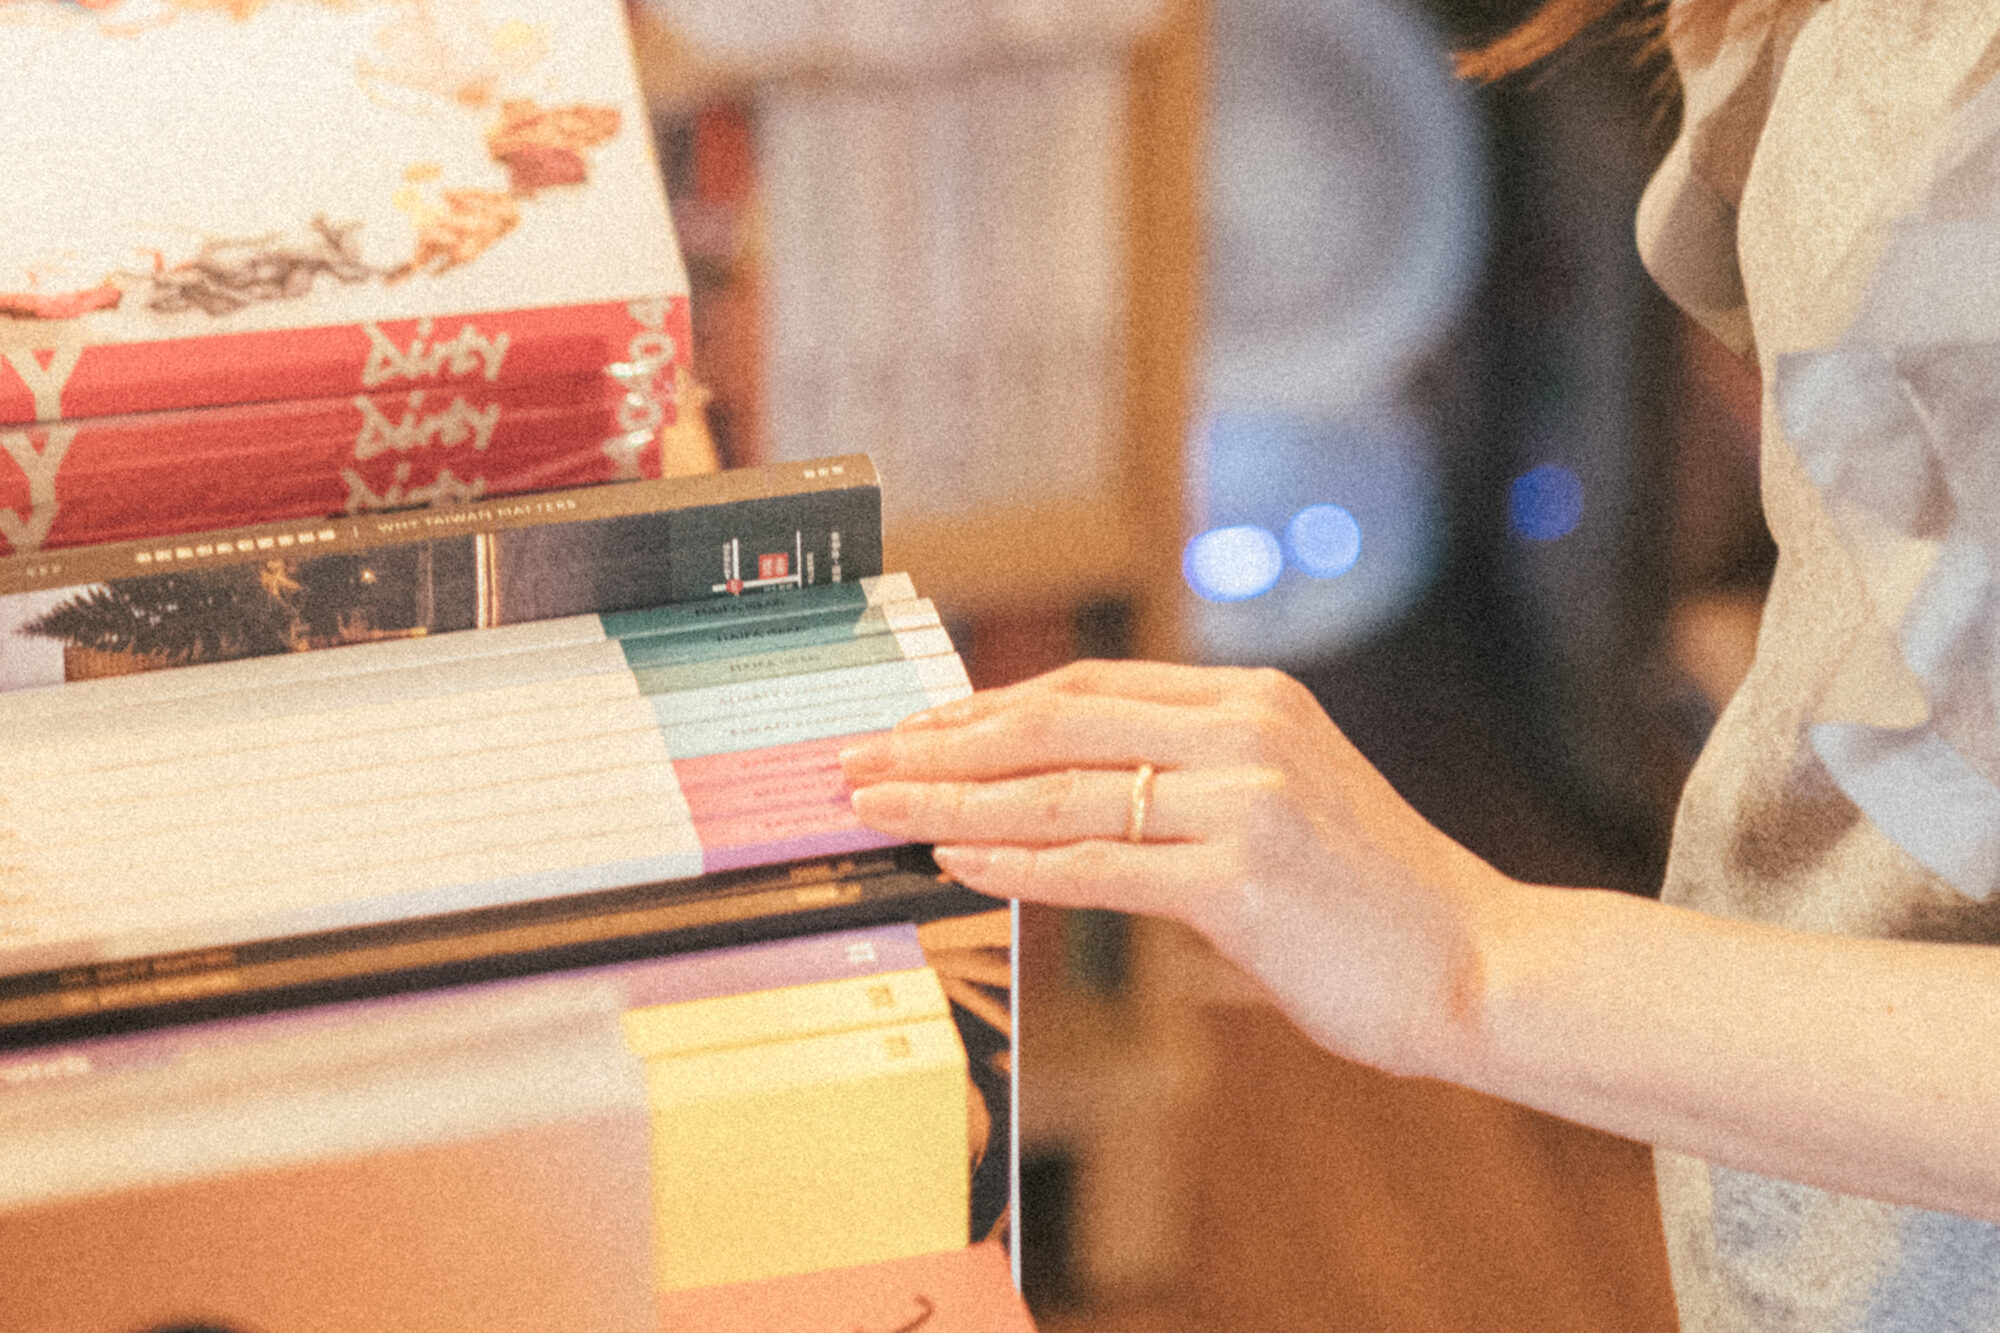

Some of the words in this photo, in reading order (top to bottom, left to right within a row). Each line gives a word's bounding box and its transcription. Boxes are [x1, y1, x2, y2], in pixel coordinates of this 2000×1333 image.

[362, 317, 511, 386] Dirty
[354, 390, 502, 460] Dirty
[424, 510, 493, 527] TAIWAN
